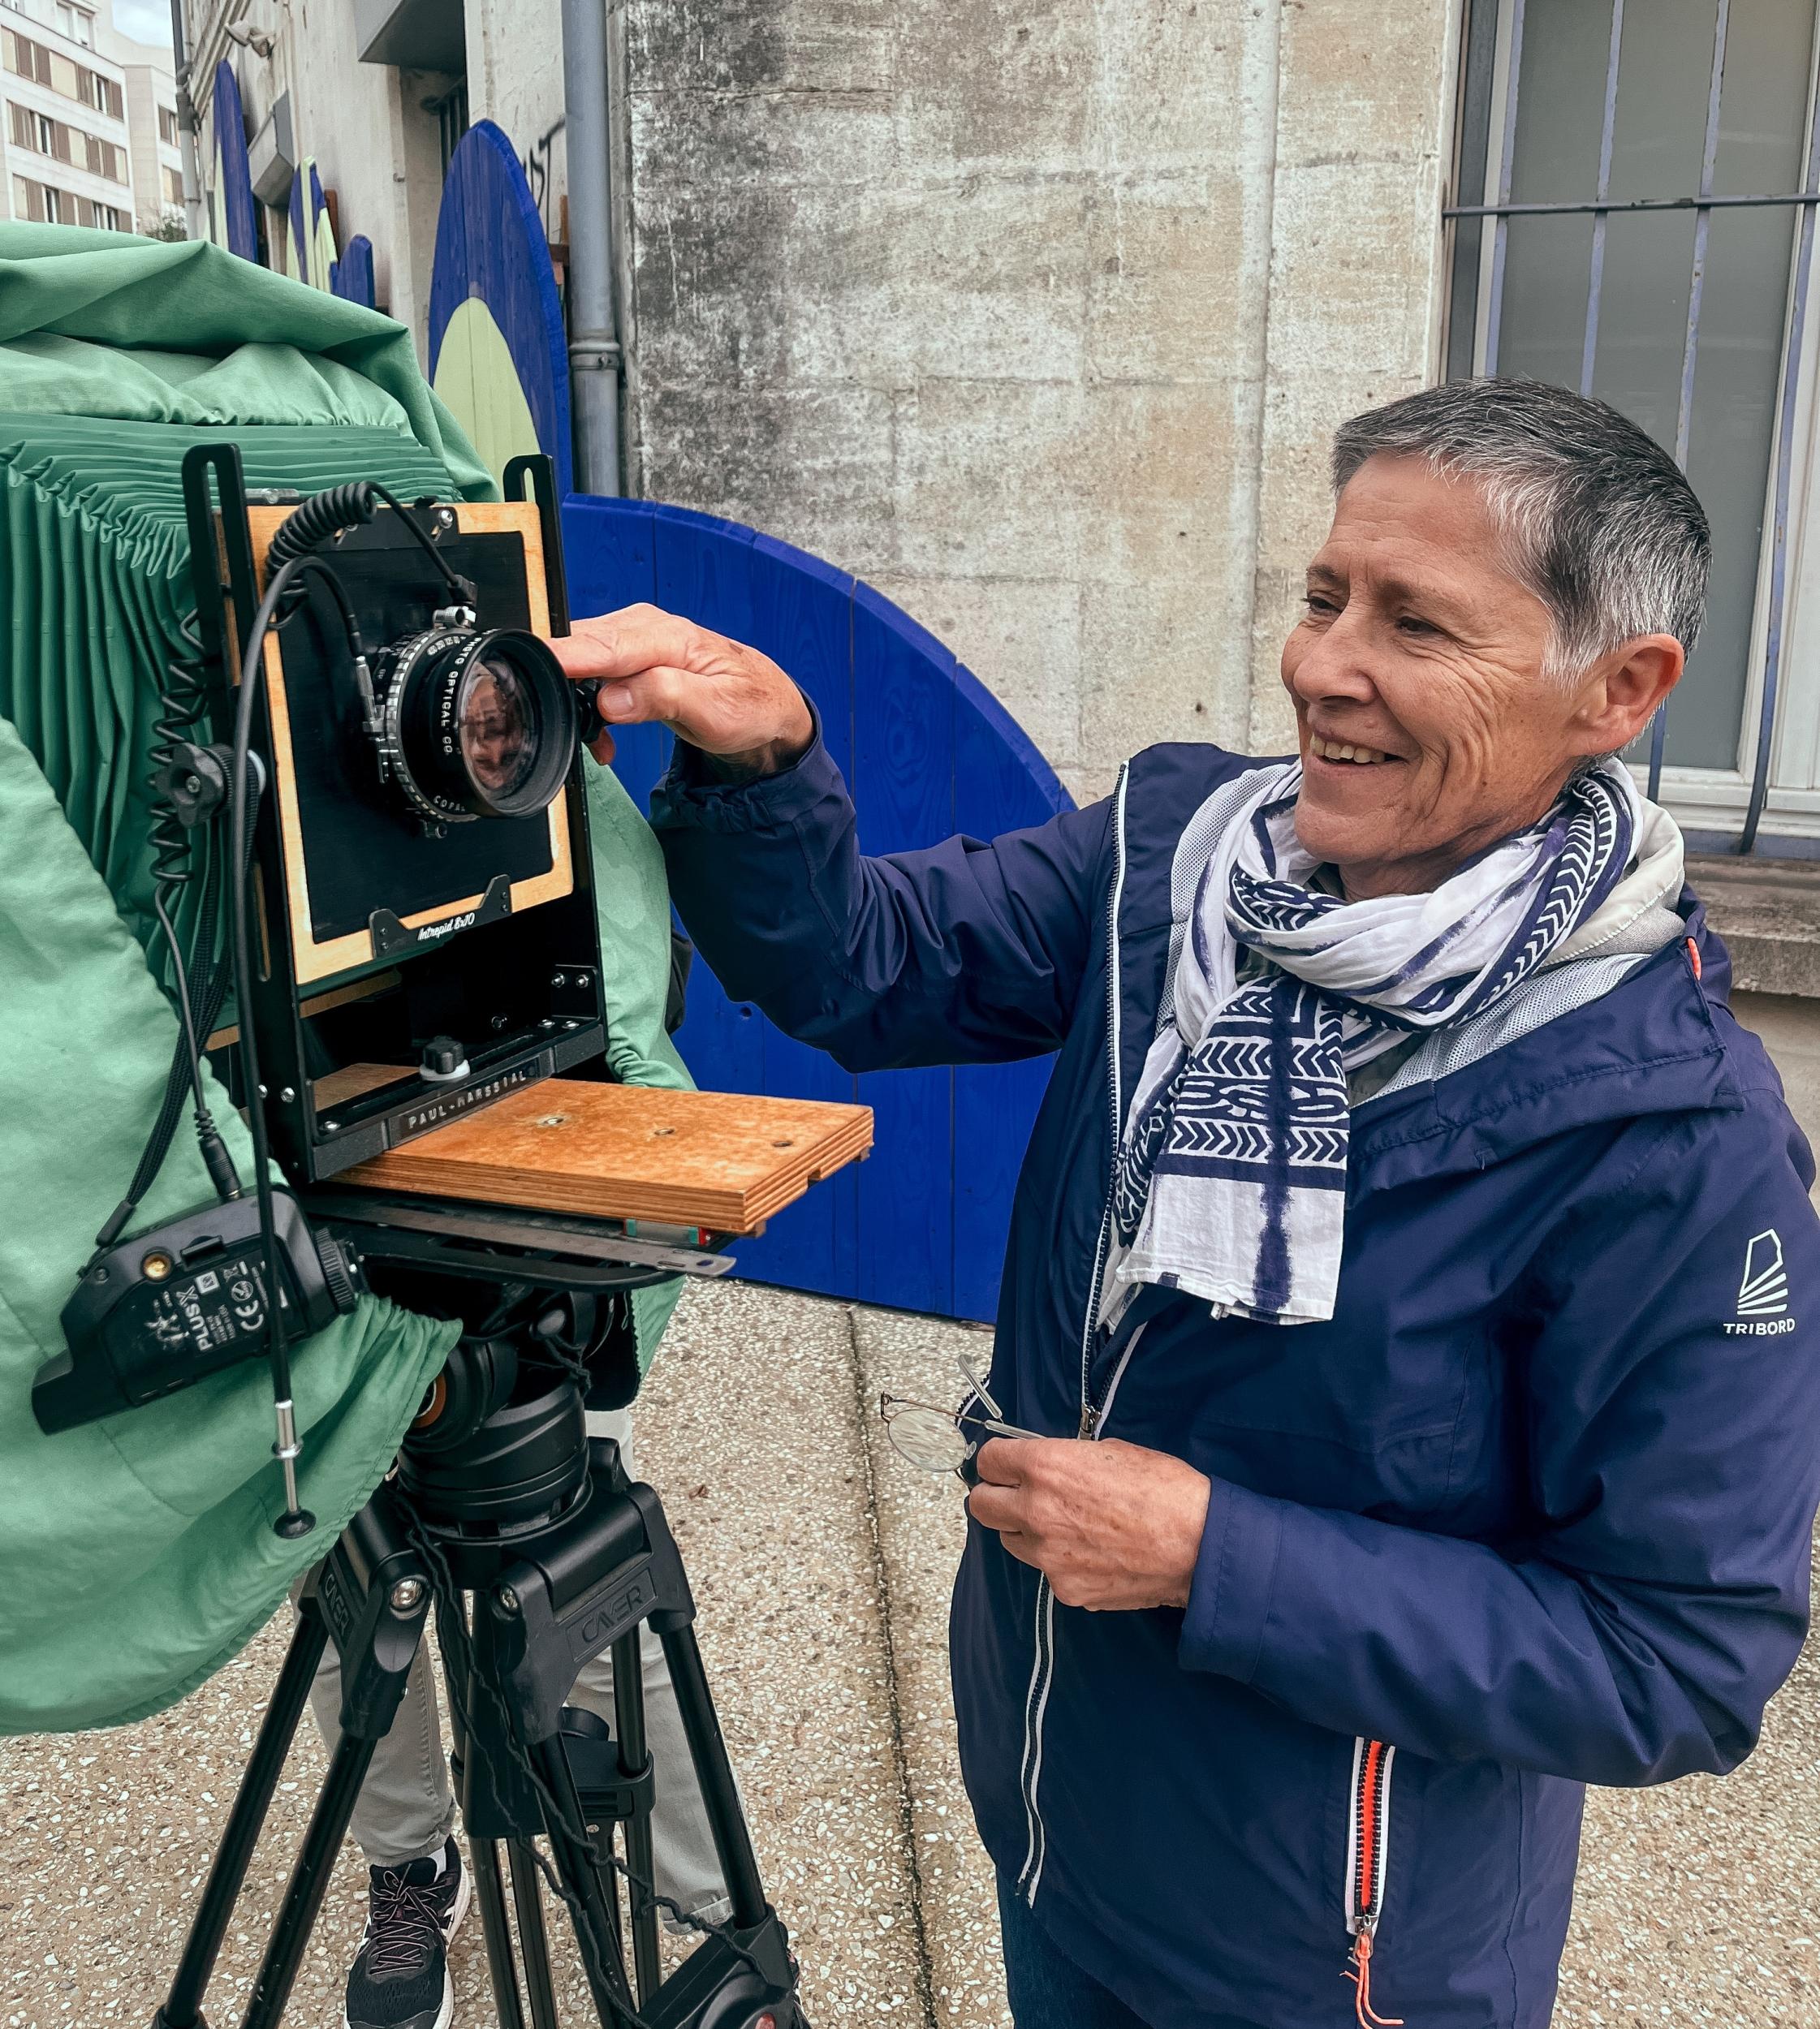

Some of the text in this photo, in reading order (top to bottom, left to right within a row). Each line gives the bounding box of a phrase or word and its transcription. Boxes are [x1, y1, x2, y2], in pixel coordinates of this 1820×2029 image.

[441, 671, 458, 726] OPTICAL
[417, 912, 475, 941] Intrepid 8x10
[1723, 1318, 1796, 1336] TRIBORD
